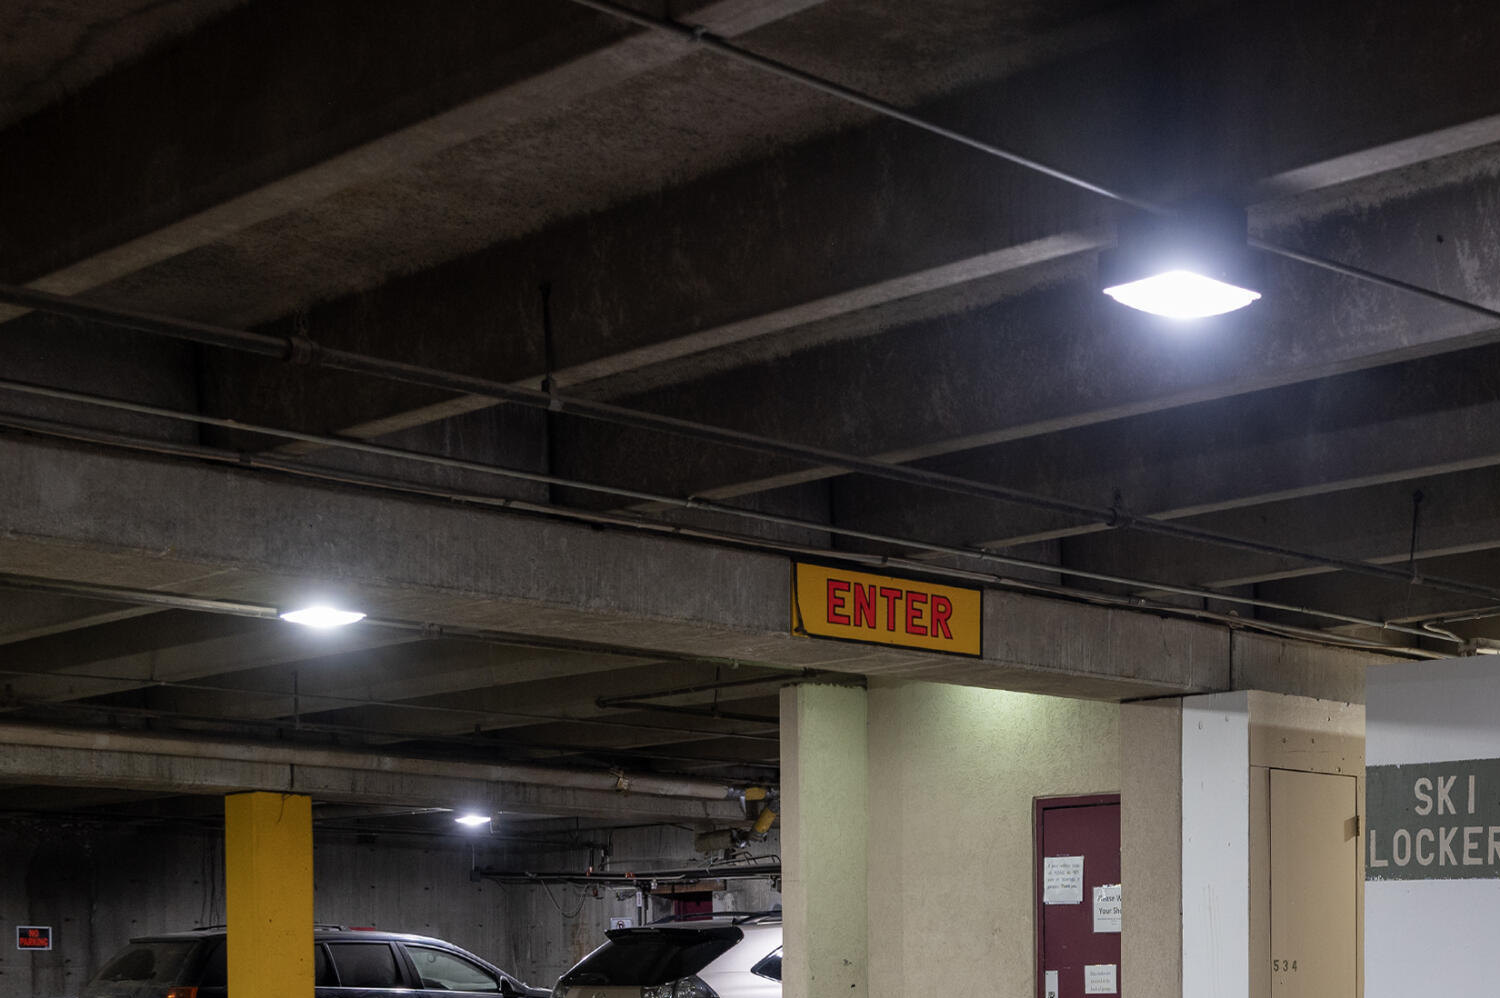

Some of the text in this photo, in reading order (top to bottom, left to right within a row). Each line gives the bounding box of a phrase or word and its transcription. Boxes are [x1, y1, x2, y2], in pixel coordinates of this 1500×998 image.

[827, 578, 953, 640] ENTER
[1414, 775, 1475, 816] SKI
[1098, 907, 1112, 915] Your
[29, 929, 39, 937] NO
[20, 937, 49, 947] PARKING
[1273, 959, 1298, 972] 534
